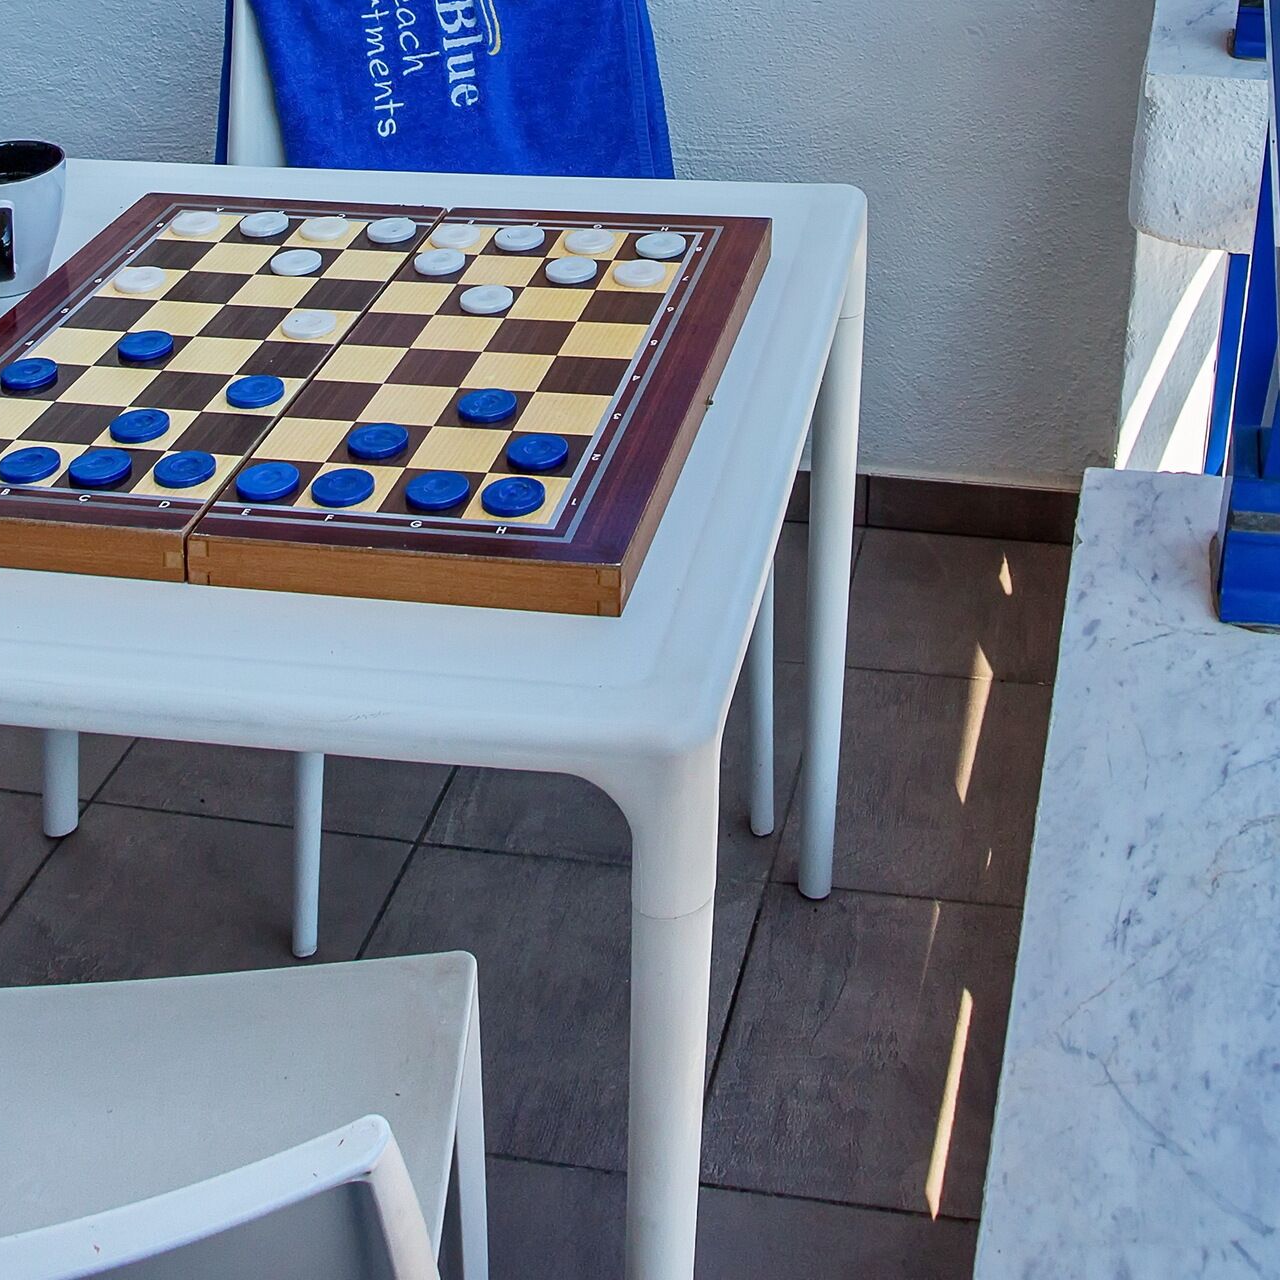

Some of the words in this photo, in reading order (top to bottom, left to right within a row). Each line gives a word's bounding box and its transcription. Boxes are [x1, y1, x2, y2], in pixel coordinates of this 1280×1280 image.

[0, 488, 11, 496] B
[78, 494, 91, 503] C
[158, 500, 171, 508] D
[241, 508, 251, 516] E
[324, 514, 335, 522] F
[410, 520, 422, 528] G
[495, 526, 508, 535] H
